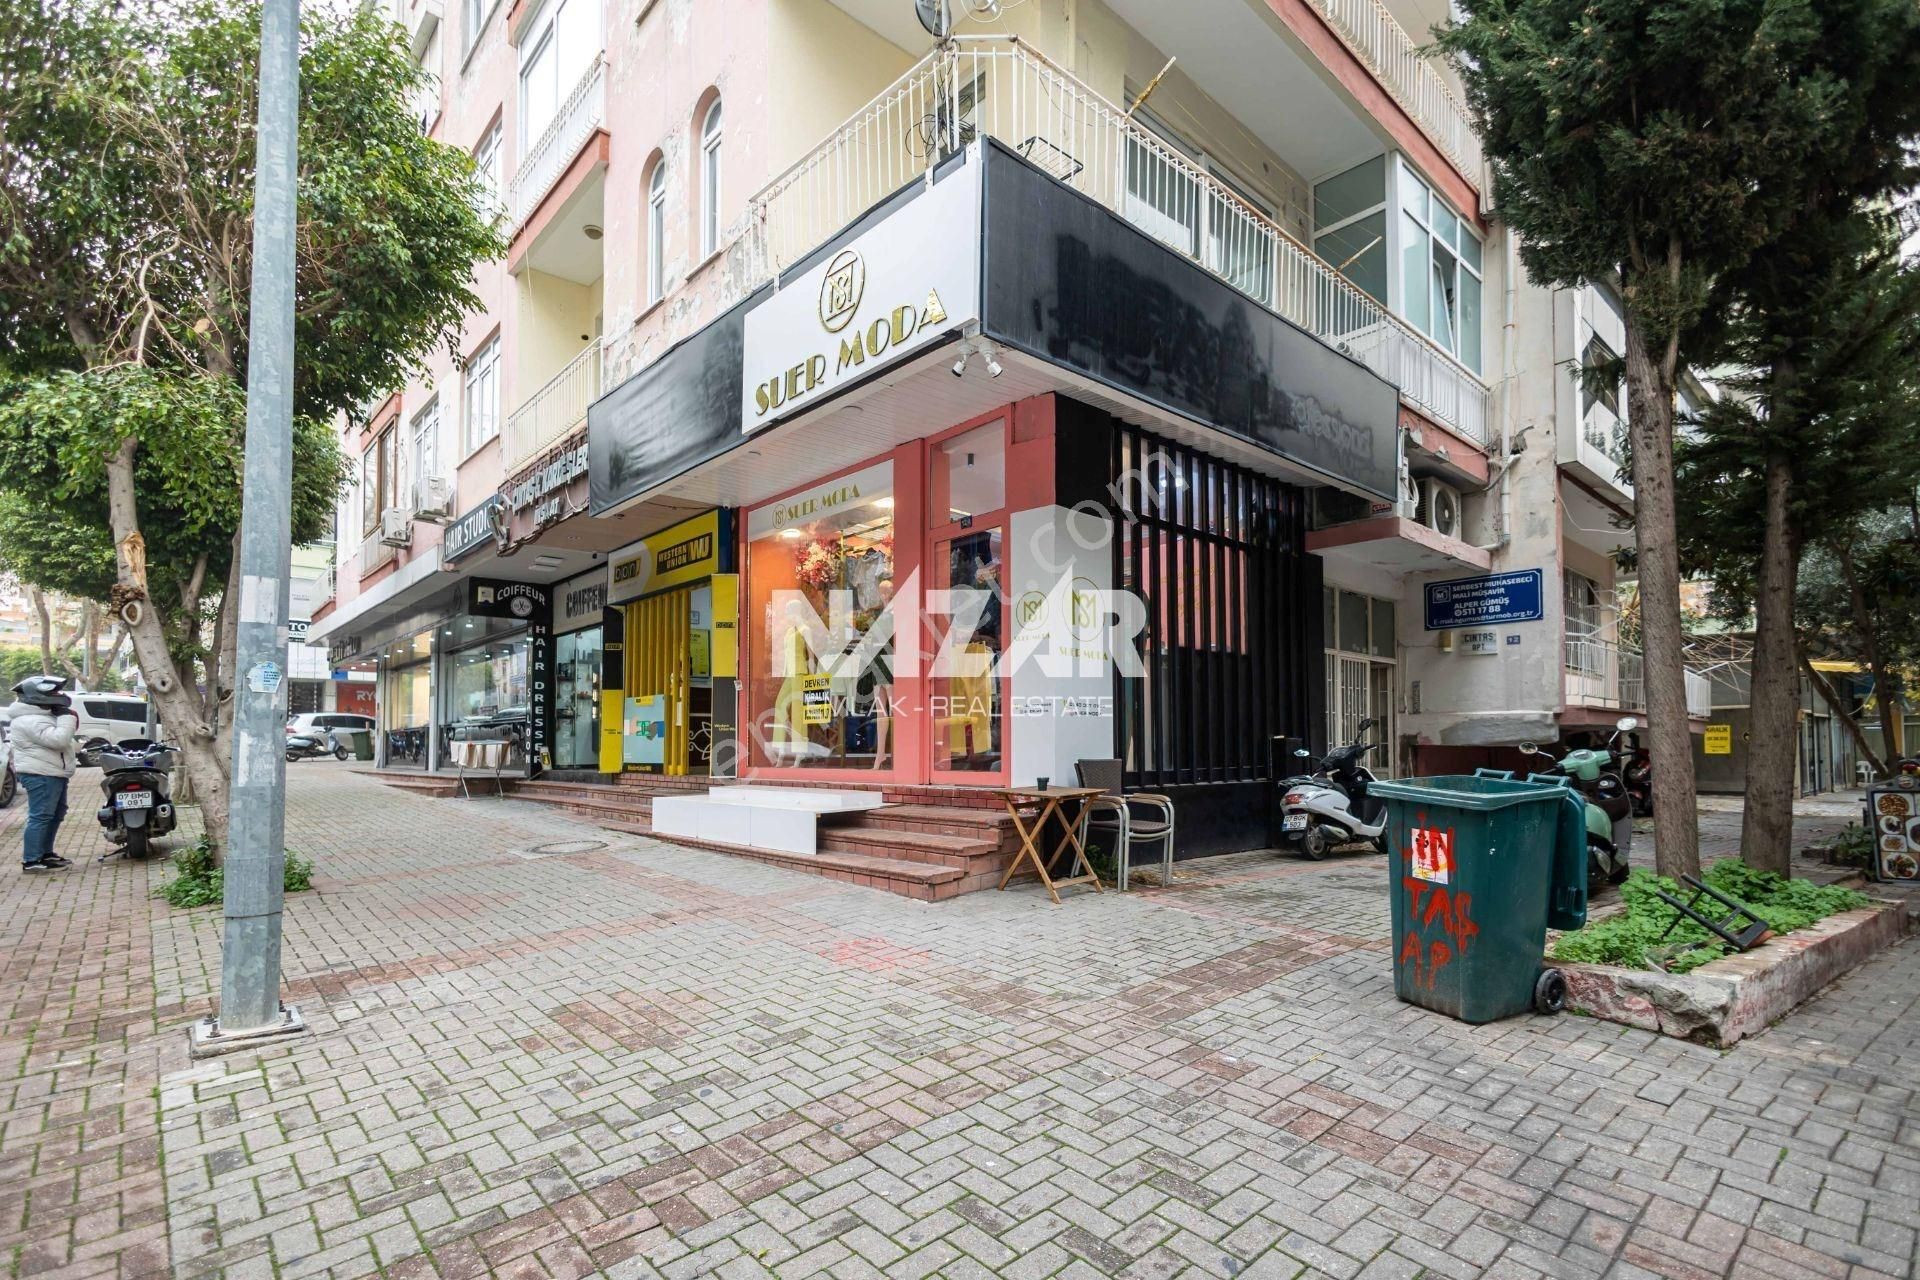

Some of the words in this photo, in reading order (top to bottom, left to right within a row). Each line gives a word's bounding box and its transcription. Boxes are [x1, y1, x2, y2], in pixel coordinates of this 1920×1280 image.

[755, 354, 827, 416] SUER
[836, 287, 948, 376] MODA
[787, 498, 818, 521] SUER
[820, 484, 860, 508] MODA
[445, 523, 463, 555] HAIR
[658, 545, 687, 562] WESTERN
[666, 555, 687, 569] UNION
[1452, 582, 1484, 592] SERBEST
[1484, 574, 1533, 588] MUHASEBECİ
[497, 584, 545, 606] COIFFEUR
[566, 584, 608, 619] COIFFEU
[1452, 591, 1471, 599] MALİ
[1454, 600, 1479, 609] ALPER
[1480, 596, 1510, 607] GÜMÜŞ
[1488, 605, 1501, 613] 88
[535, 625, 546, 671] HAIR
[804, 678, 829, 688] DEVREN
[356, 690, 377, 701] RY
[534, 681, 545, 764] DRESSER
[131, 792, 150, 800] BMD
